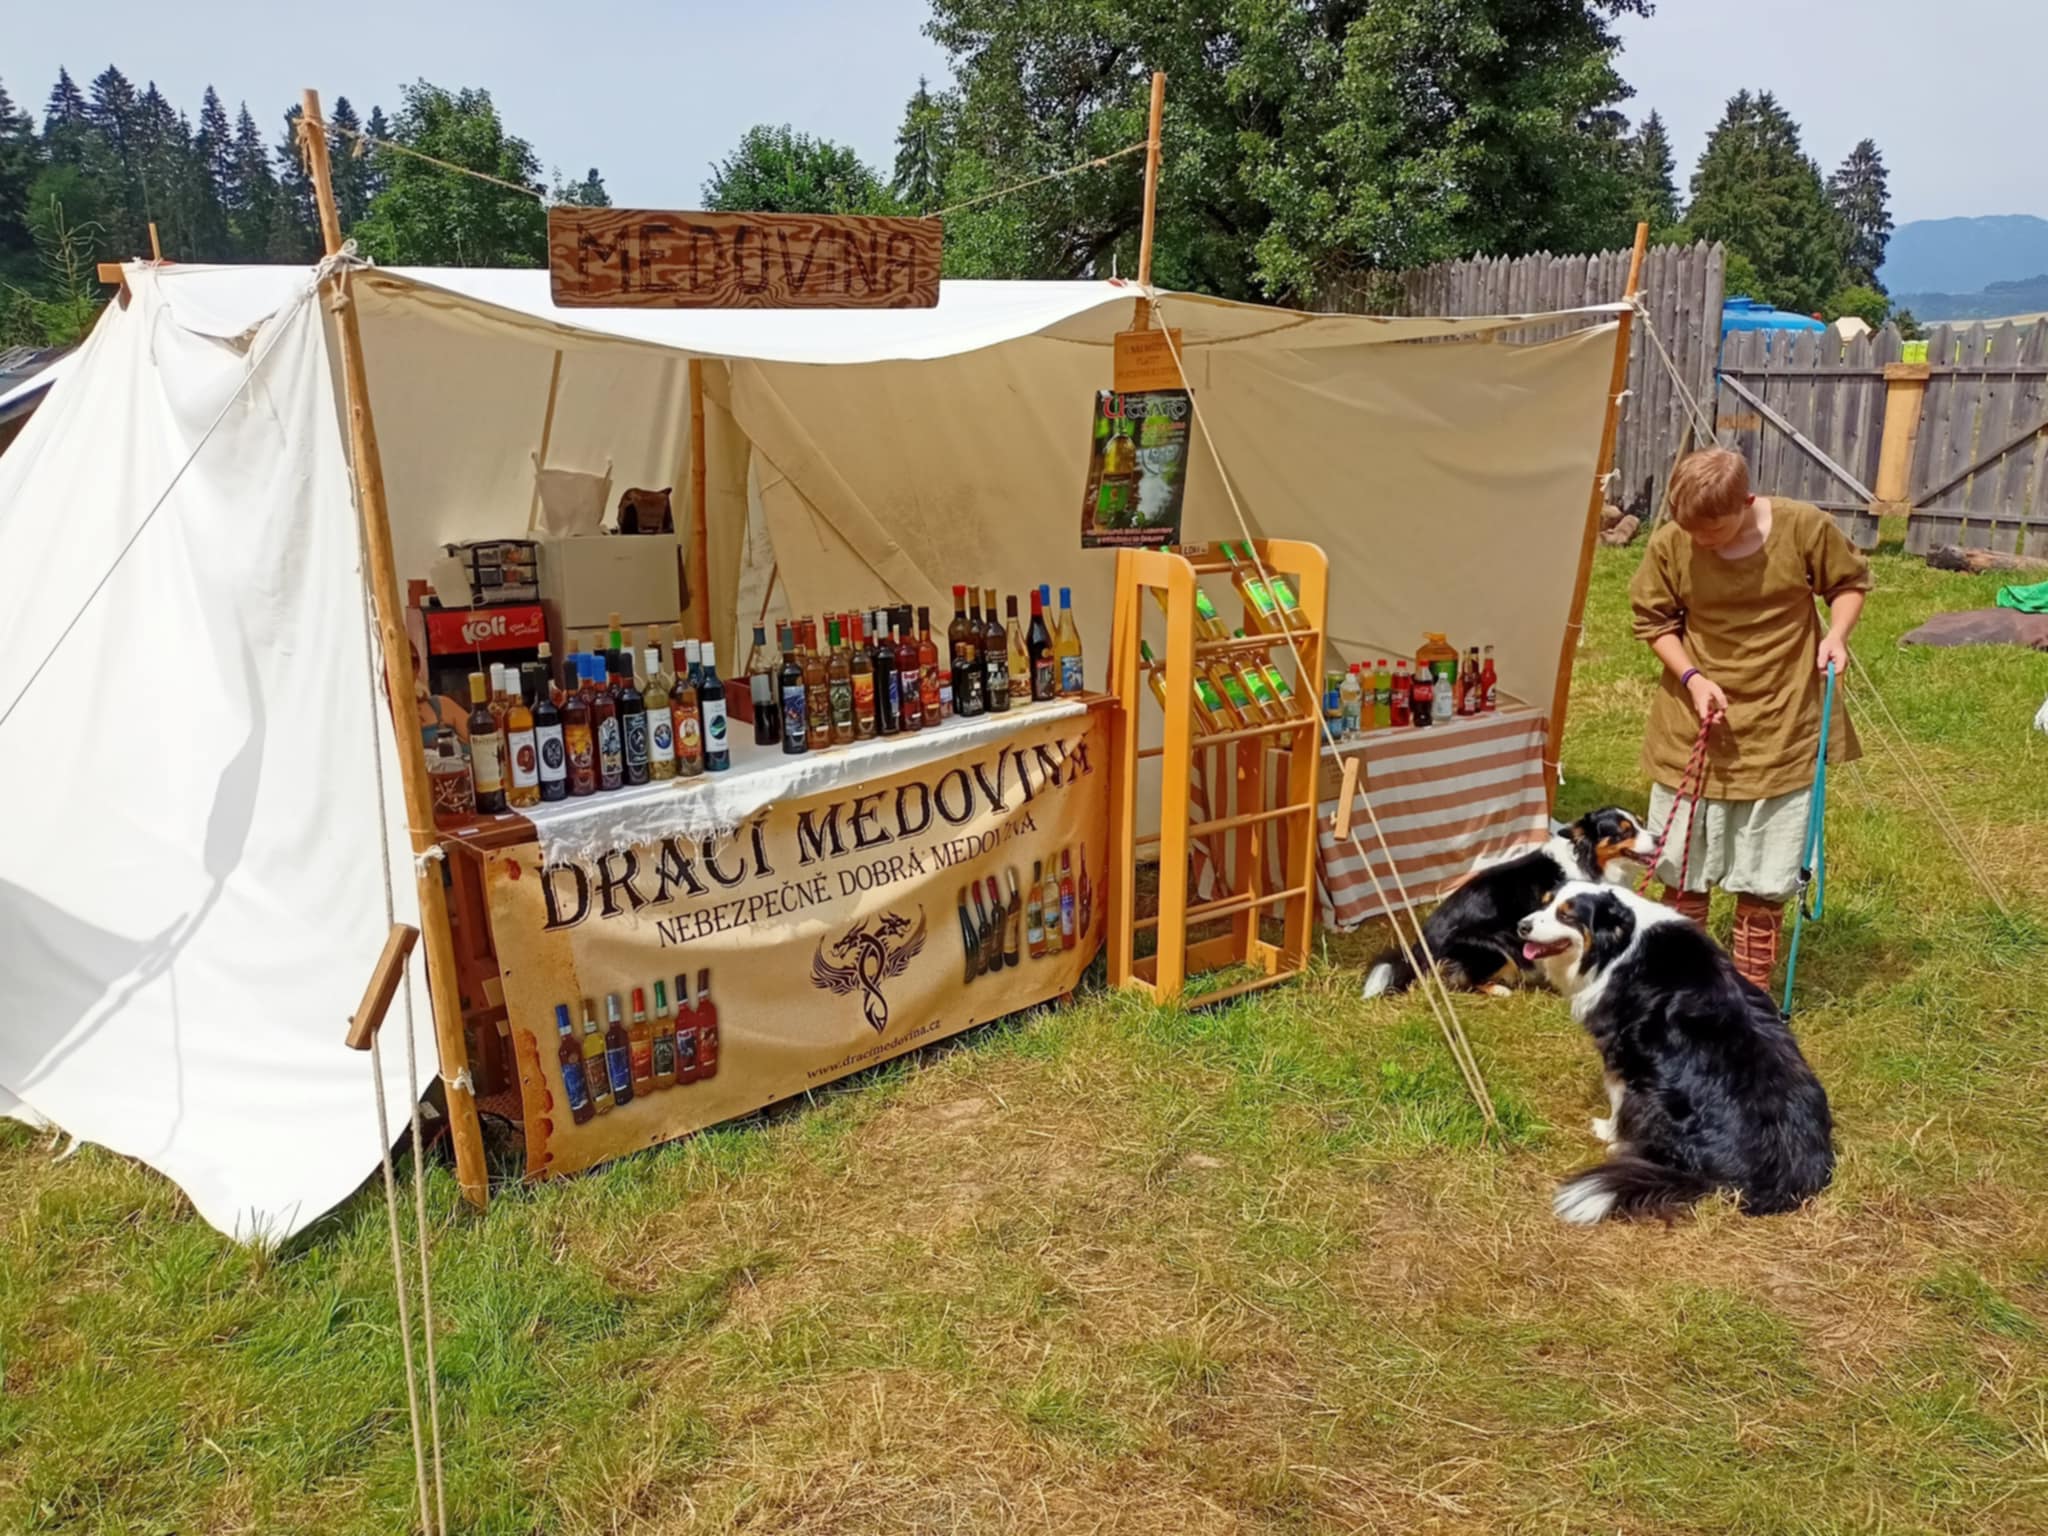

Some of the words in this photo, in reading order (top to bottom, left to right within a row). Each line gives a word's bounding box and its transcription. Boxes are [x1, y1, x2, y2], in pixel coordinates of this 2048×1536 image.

[577, 222, 916, 296] MEDOVINA
[797, 731, 1093, 867] MEDOVINA
[656, 872, 832, 948] NEBEZPEČNĚ
[838, 846, 926, 896] DOBRÁ
[807, 1019, 942, 1079] www.dracimedovina.cz
